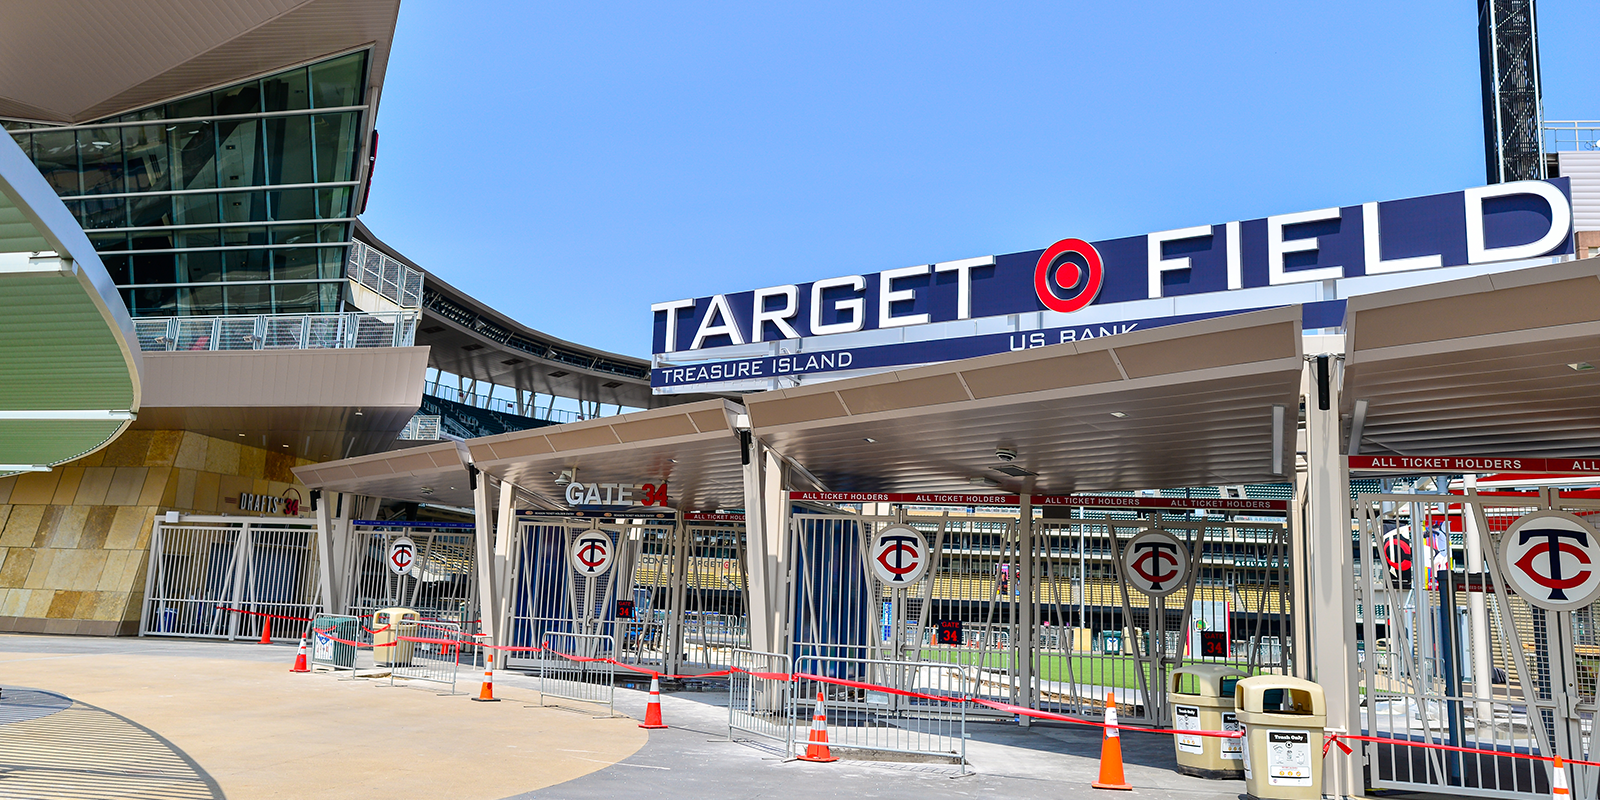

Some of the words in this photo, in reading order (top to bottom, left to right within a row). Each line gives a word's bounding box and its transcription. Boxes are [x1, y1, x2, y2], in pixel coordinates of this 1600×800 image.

[651, 254, 996, 352] TARGET
[1147, 180, 1572, 299] FIELD
[1010, 333, 1045, 351] US
[662, 359, 764, 384] TREASURE
[772, 352, 853, 373] ISLAND
[1371, 458, 1397, 467] ALL
[1401, 458, 1450, 468] TICKET
[1455, 459, 1522, 469] HOLDERS
[1572, 460, 1600, 470] ALL
[565, 482, 634, 506] GATE
[641, 483, 668, 507] 34
[240, 492, 279, 514] DRAFTS
[284, 498, 299, 516] 34
[619, 607, 629, 616] 34
[943, 630, 958, 642] 34
[1207, 642, 1222, 654] 34
